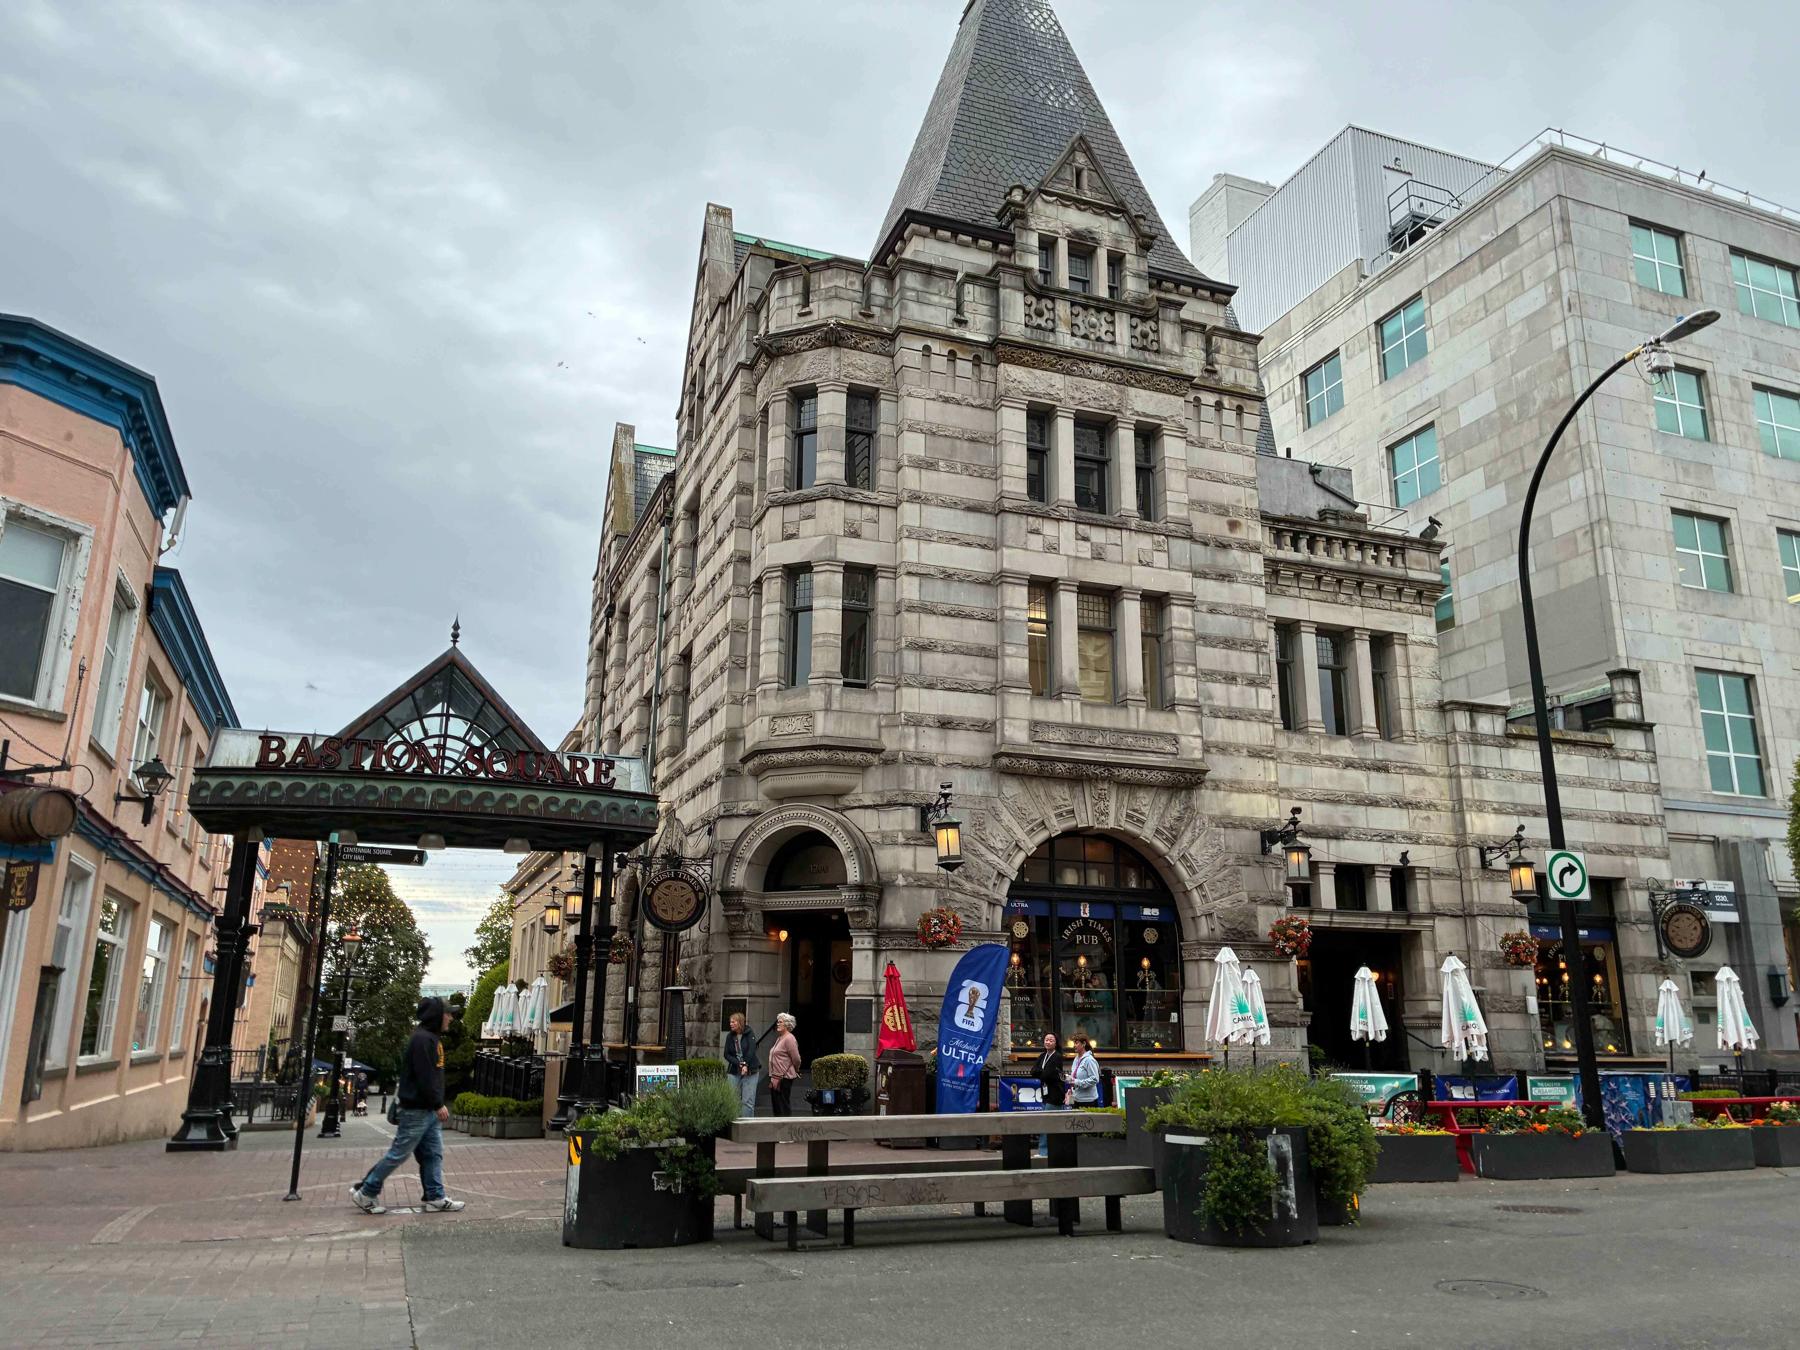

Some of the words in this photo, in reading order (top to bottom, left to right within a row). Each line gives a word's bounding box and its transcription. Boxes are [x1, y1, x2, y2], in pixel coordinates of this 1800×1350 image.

[255, 735, 442, 774] BASTION
[463, 745, 616, 788] SQUARE
[343, 846, 372, 855] CENTENNIAL
[650, 871, 675, 886] IRISH
[677, 871, 701, 892] TIMES
[9, 898, 26, 906] PUB
[1061, 919, 1083, 940] IRISH
[1088, 919, 1113, 943] TIMES
[1075, 934, 1099, 945] PUB
[962, 1018, 975, 1027] FIFA
[941, 1044, 984, 1065] ULTRA
